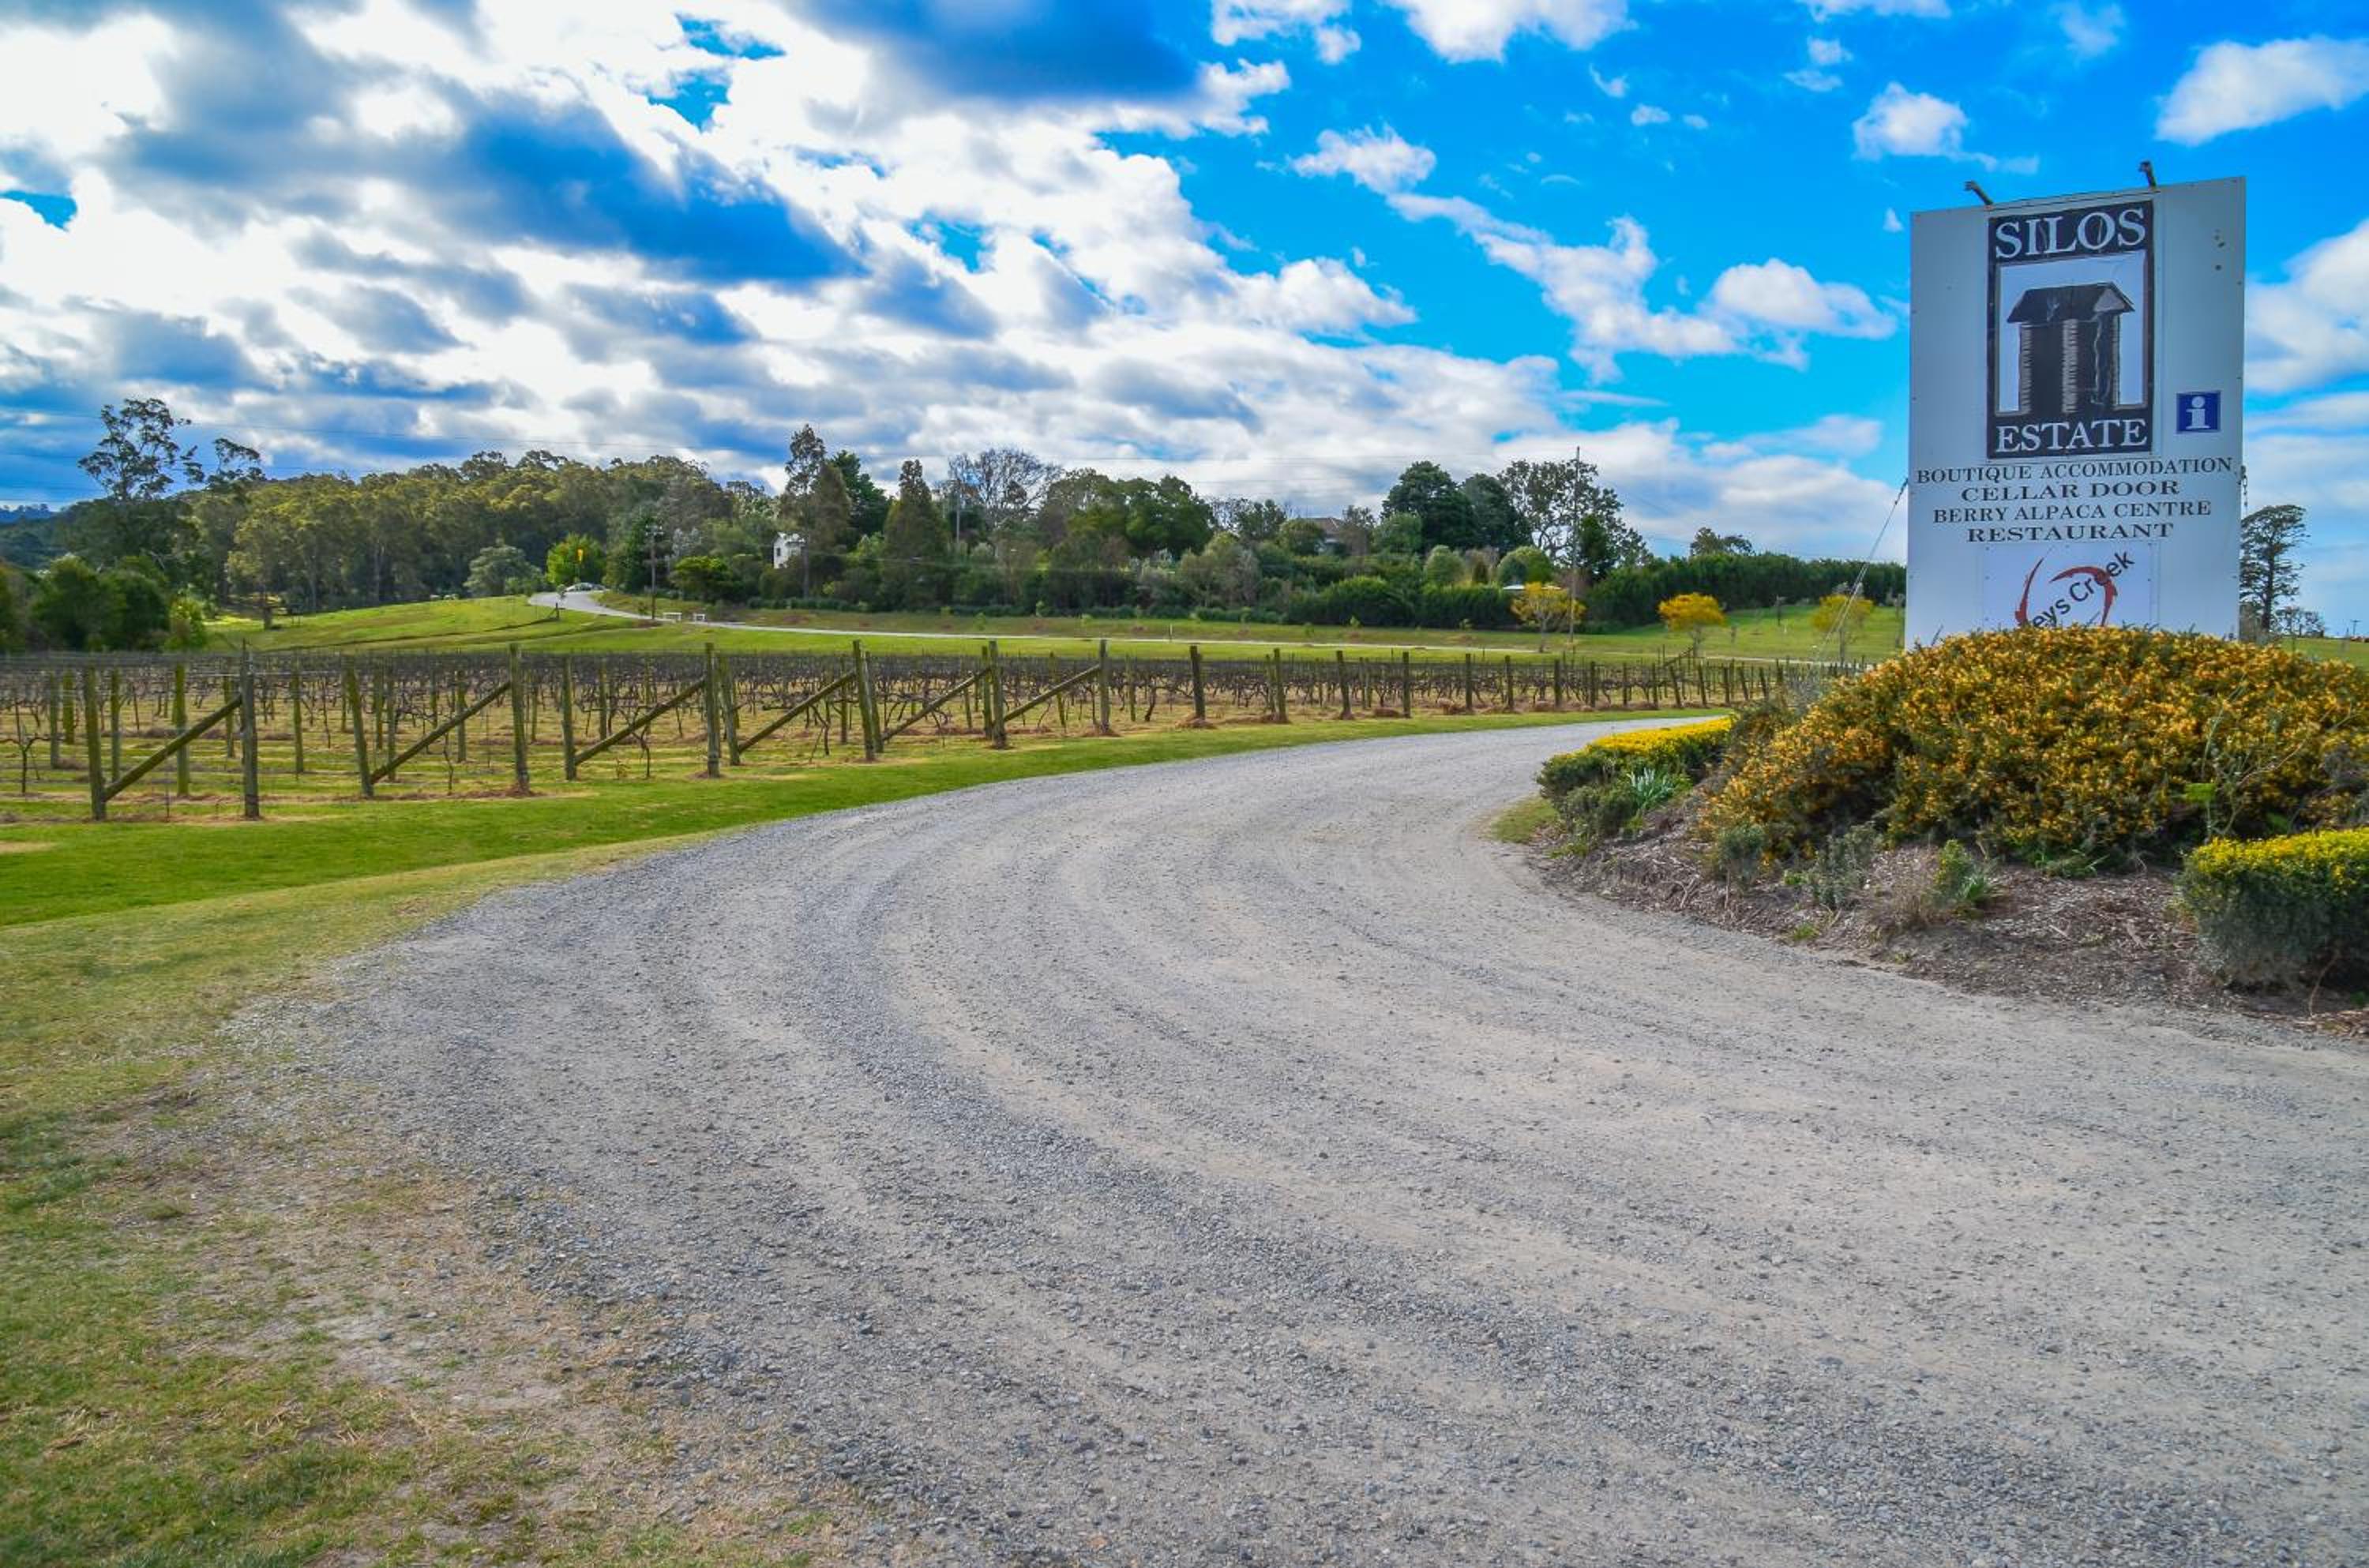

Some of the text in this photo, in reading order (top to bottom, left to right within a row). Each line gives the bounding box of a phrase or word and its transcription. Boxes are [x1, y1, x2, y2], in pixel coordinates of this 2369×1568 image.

[1995, 208, 2146, 258] SILOS
[1995, 418, 2147, 452] ESTATE
[1917, 457, 2232, 484] BOUTIQUE ACCOMMODATION
[1962, 481, 2179, 501] CELLAR DOOR
[1934, 500, 2211, 523] BERRY ALPACA CENTRE
[1967, 523, 2174, 542] RESTAURANT
[2070, 552, 2135, 602] Creek
